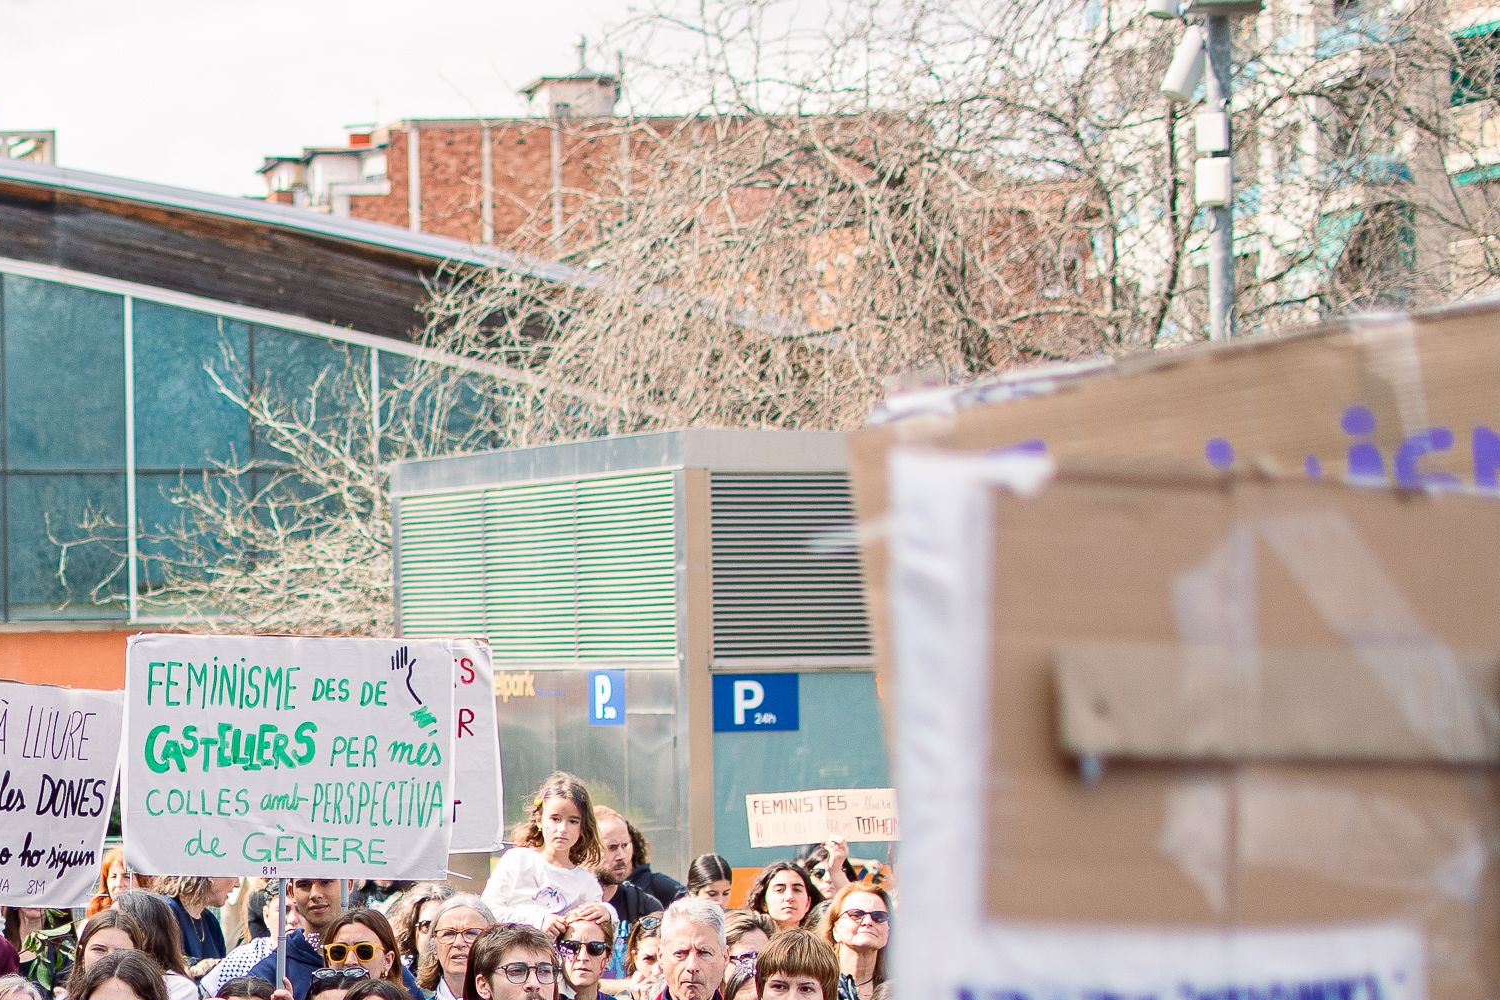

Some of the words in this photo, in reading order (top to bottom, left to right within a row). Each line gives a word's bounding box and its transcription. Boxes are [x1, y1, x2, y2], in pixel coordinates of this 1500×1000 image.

[312, 677, 350, 702] DES
[360, 681, 388, 706] DE
[733, 680, 765, 725] P
[144, 721, 318, 774] CASTELLERS
[330, 735, 378, 768] PER
[387, 729, 442, 766] més
[35, 773, 107, 818] DONES
[145, 788, 250, 817] COLLES
[184, 829, 227, 857] de
[241, 824, 389, 866] GÈNERE
[26, 879, 46, 895] 8M
